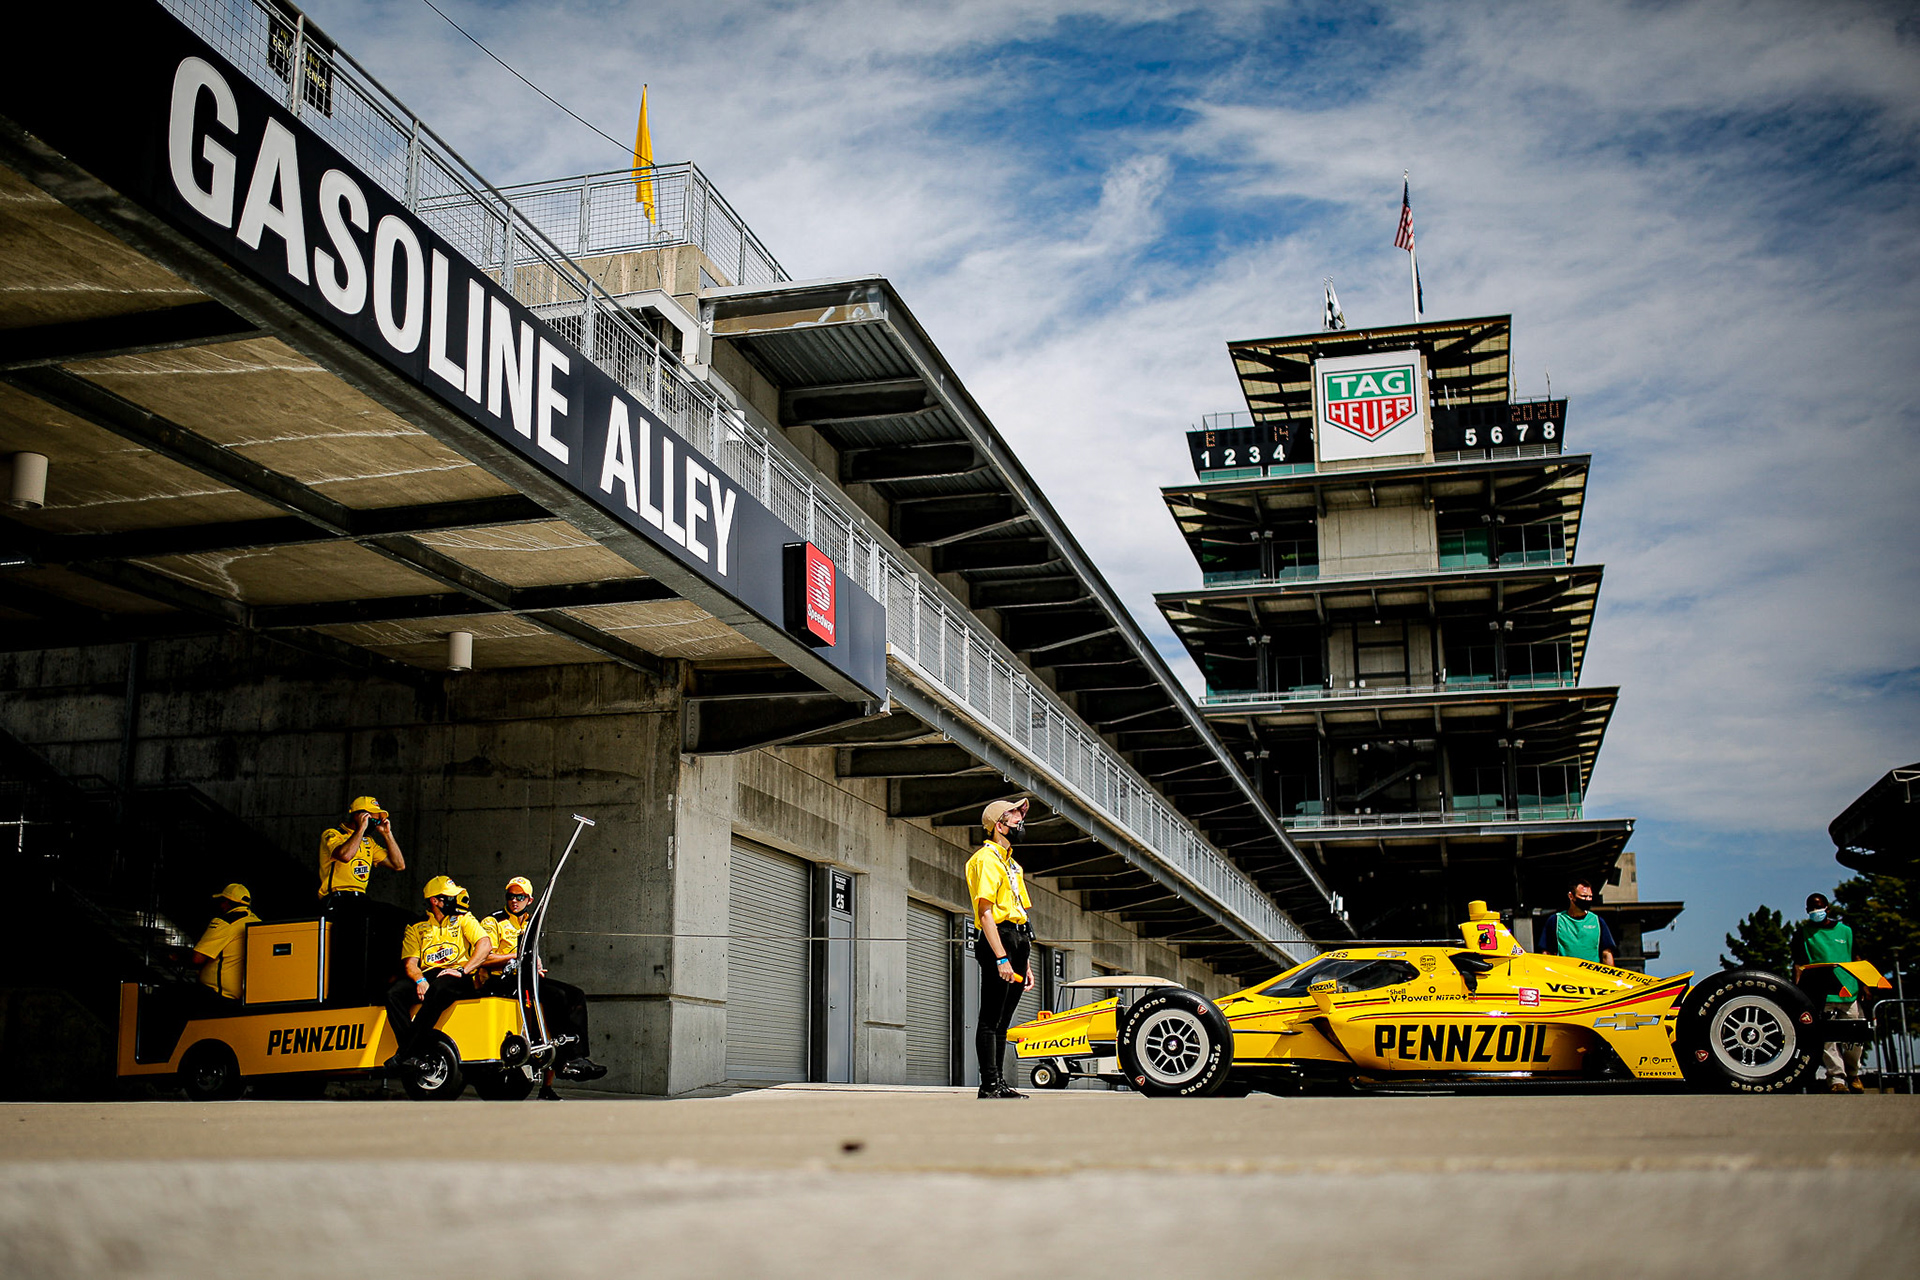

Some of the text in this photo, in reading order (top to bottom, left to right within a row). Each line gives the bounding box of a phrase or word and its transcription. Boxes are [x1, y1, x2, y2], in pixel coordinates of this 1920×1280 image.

[169, 56, 737, 577] GASOLINE ALLEY
[1331, 372, 1406, 398] TAG
[1330, 398, 1410, 435] HEUER
[1510, 401, 1560, 422] 2020
[1465, 421, 1556, 446] 5 6 7 8
[1201, 444, 1286, 468] 1 2 3 4
[807, 603, 834, 636] Speedway
[836, 893, 845, 909] 25
[1477, 924, 1498, 950] 3
[1578, 961, 1625, 978] PENSKE
[1390, 994, 1433, 1003] V-Power
[1699, 980, 1777, 1016] Firestone
[1123, 997, 1167, 1045] Firestone
[267, 1023, 368, 1056] PENNZOIL
[1024, 1034, 1087, 1051] HITACHI
[1374, 1024, 1552, 1063] PENNZOIL
[1180, 1043, 1222, 1095] Firestone
[1730, 1054, 1811, 1093] Firestone
